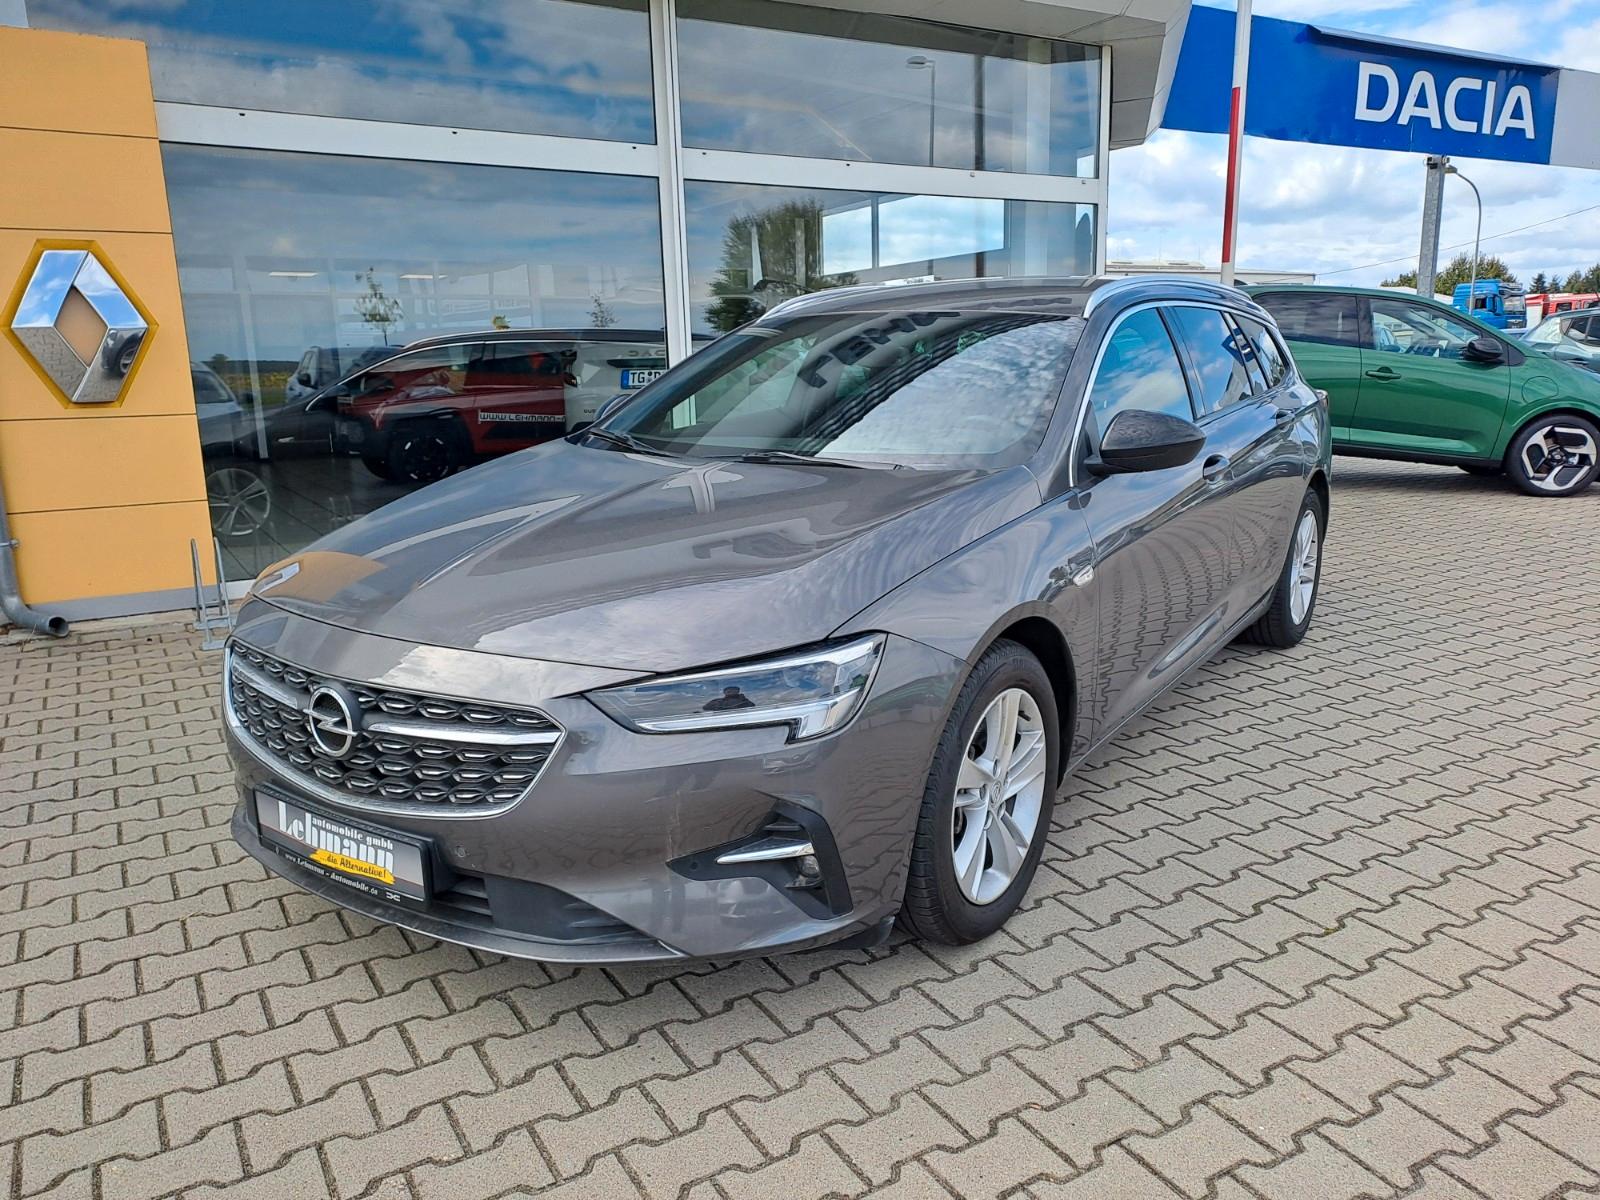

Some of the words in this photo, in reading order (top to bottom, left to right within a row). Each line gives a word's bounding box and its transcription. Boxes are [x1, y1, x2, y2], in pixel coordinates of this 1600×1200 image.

[1355, 61, 1535, 139] DACIA
[278, 800, 394, 873] Lehmann
[312, 817, 363, 841] automobile
[366, 836, 393, 850] gmbh
[339, 857, 386, 878] Alternative!
